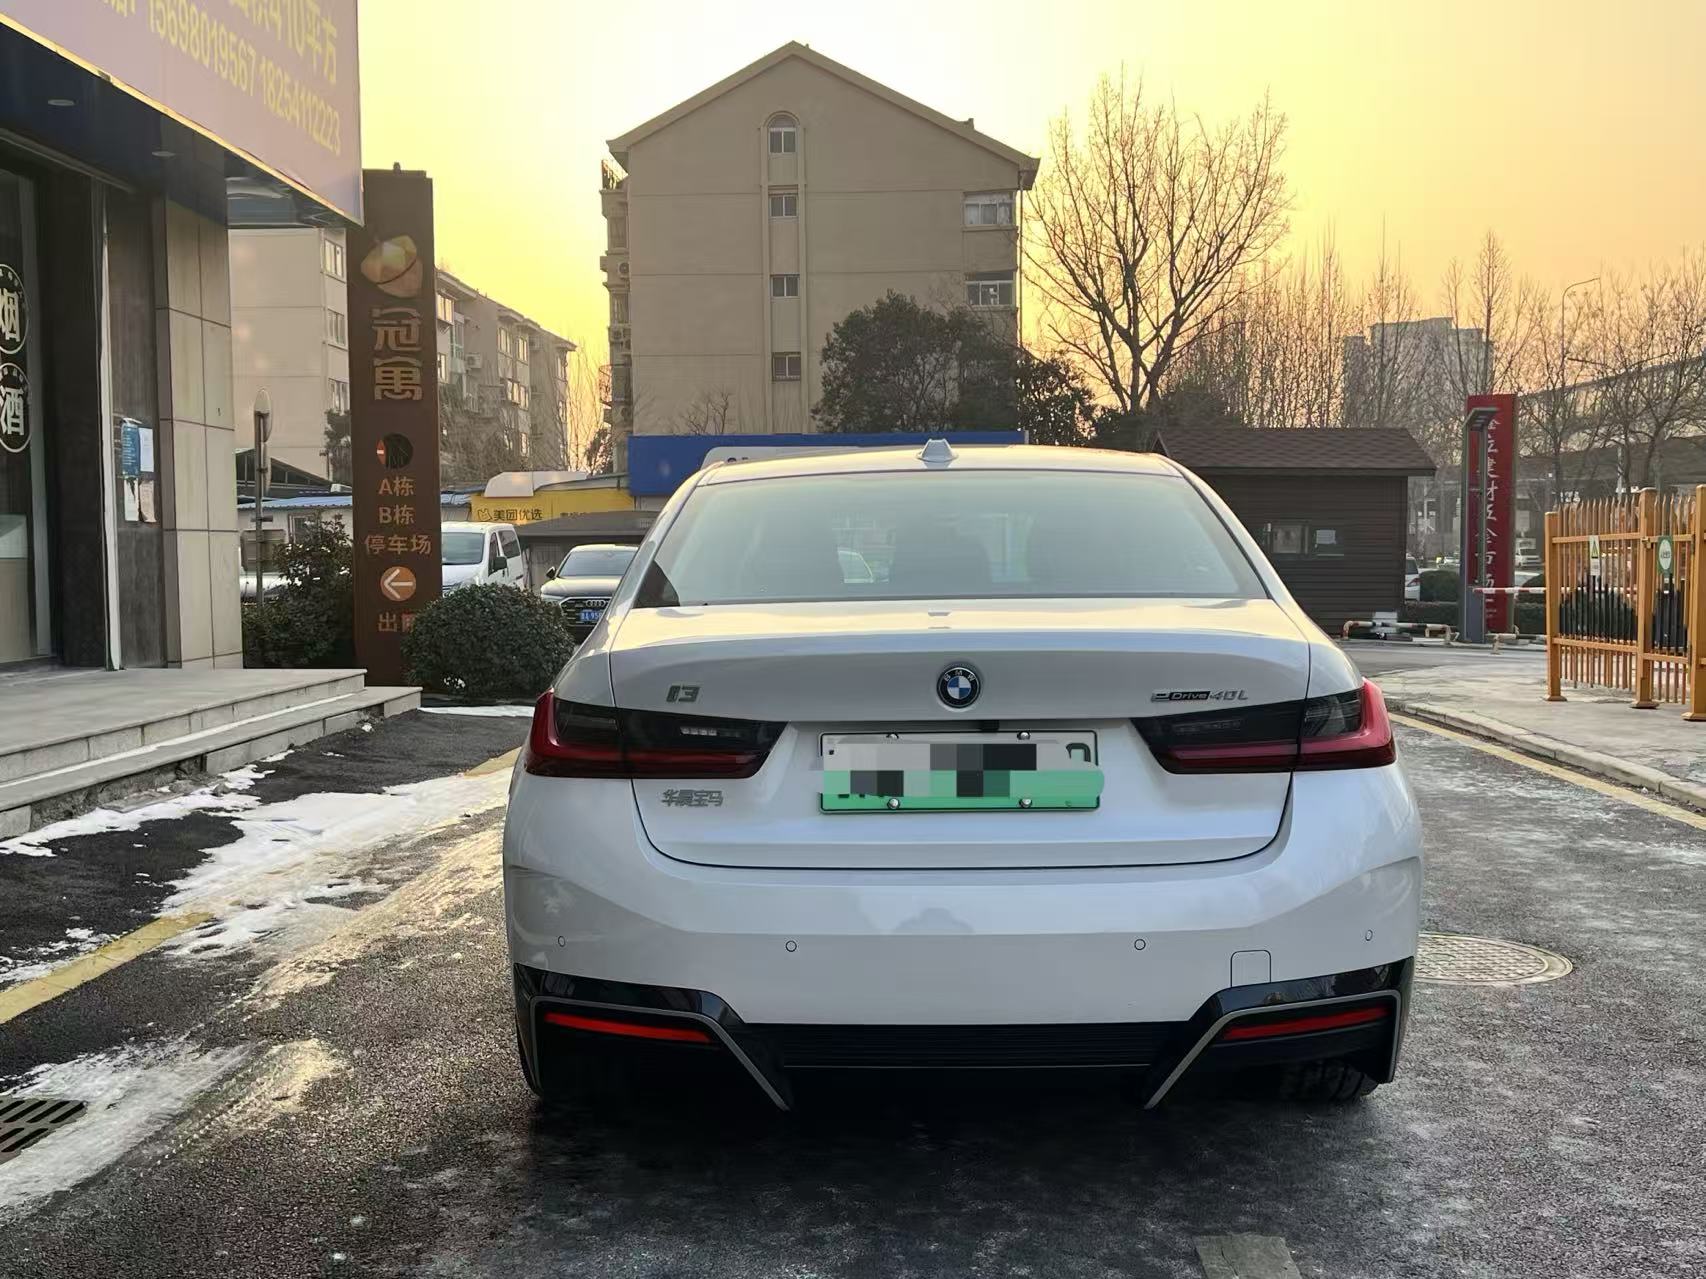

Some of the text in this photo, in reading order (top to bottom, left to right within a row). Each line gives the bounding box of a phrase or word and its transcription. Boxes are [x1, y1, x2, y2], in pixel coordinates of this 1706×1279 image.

[378, 476, 415, 496] A栋
[378, 504, 415, 525] B栋
[493, 508, 543, 521] 美团优选
[364, 534, 432, 555] 停车场
[943, 669, 977, 682] BMW
